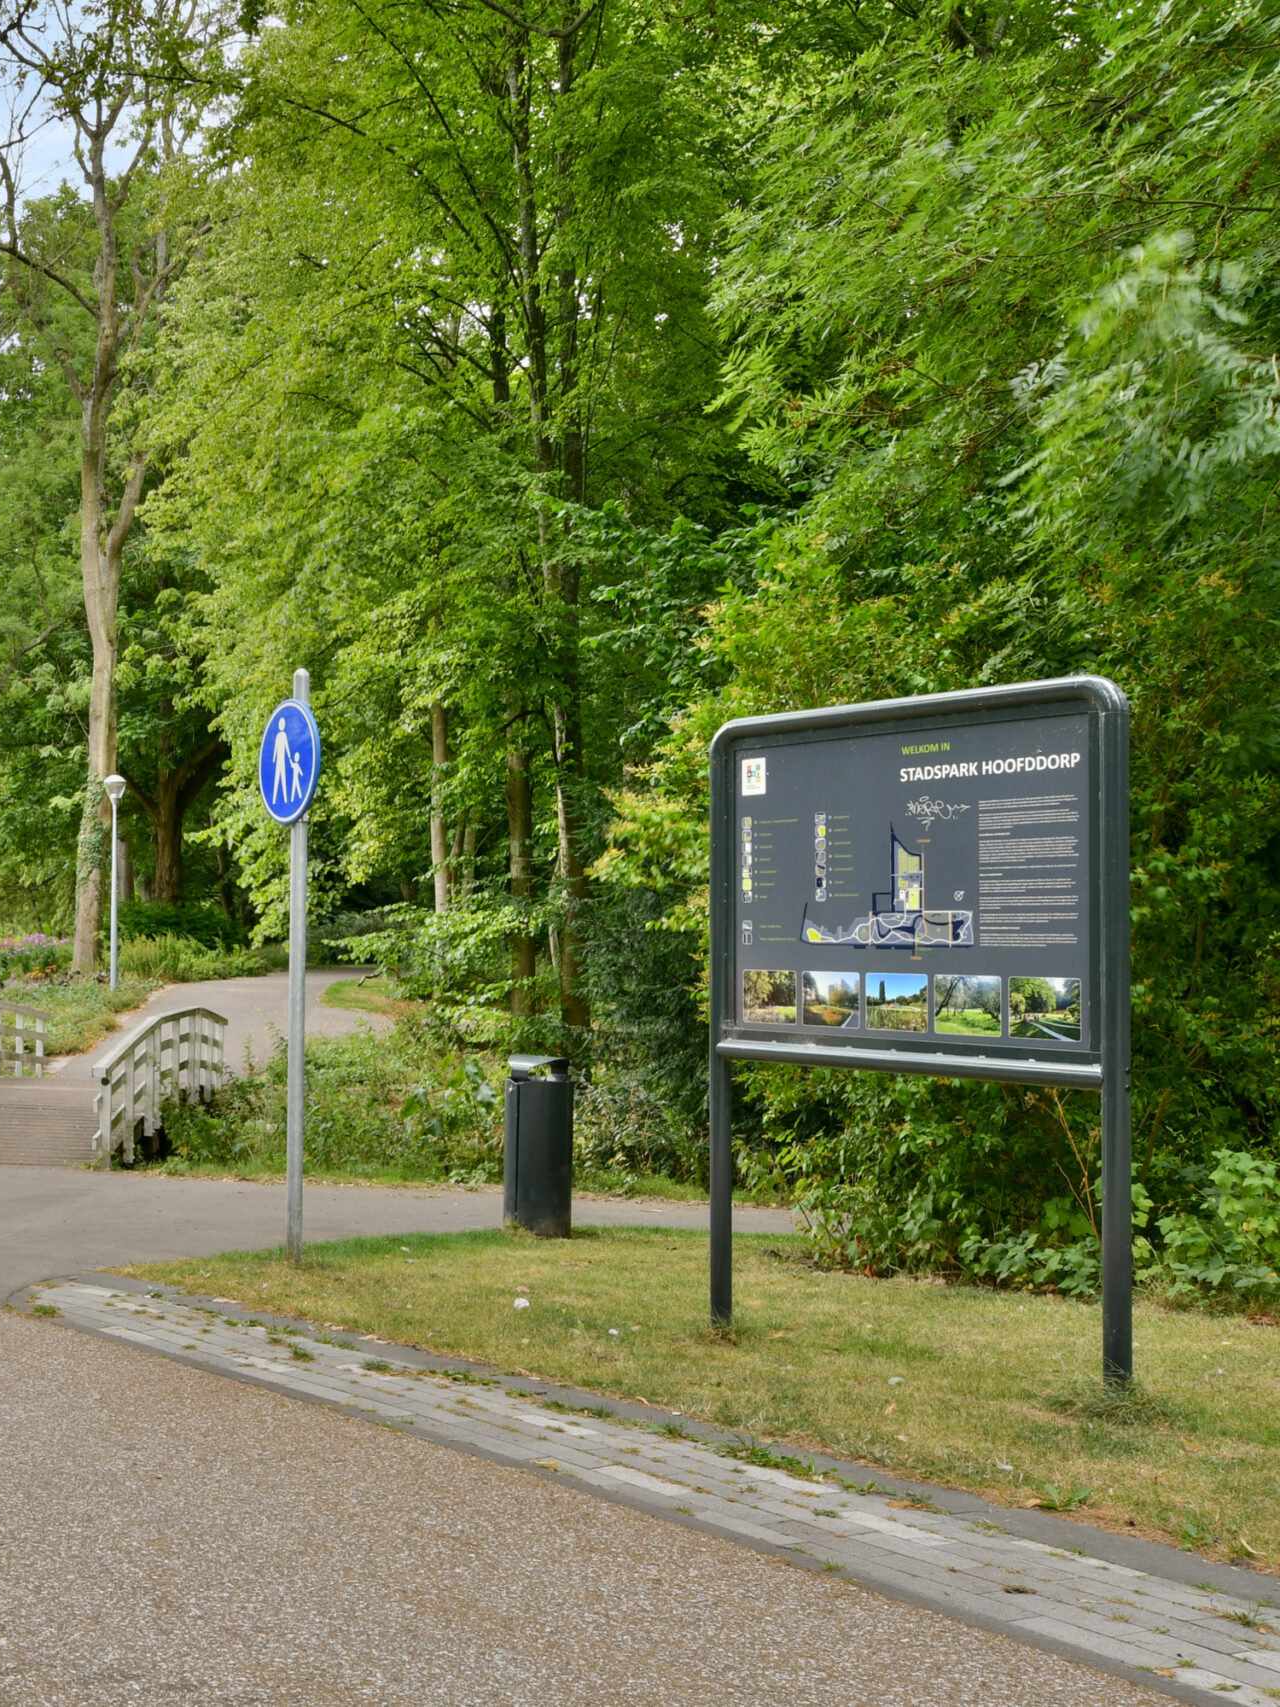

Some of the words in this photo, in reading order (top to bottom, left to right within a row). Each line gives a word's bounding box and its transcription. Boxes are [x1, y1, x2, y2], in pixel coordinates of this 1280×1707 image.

[901, 743, 939, 756] WELKOM
[941, 742, 951, 752] IN
[900, 762, 979, 782] STADSPARK
[982, 753, 1081, 775] HOOFDDORP
